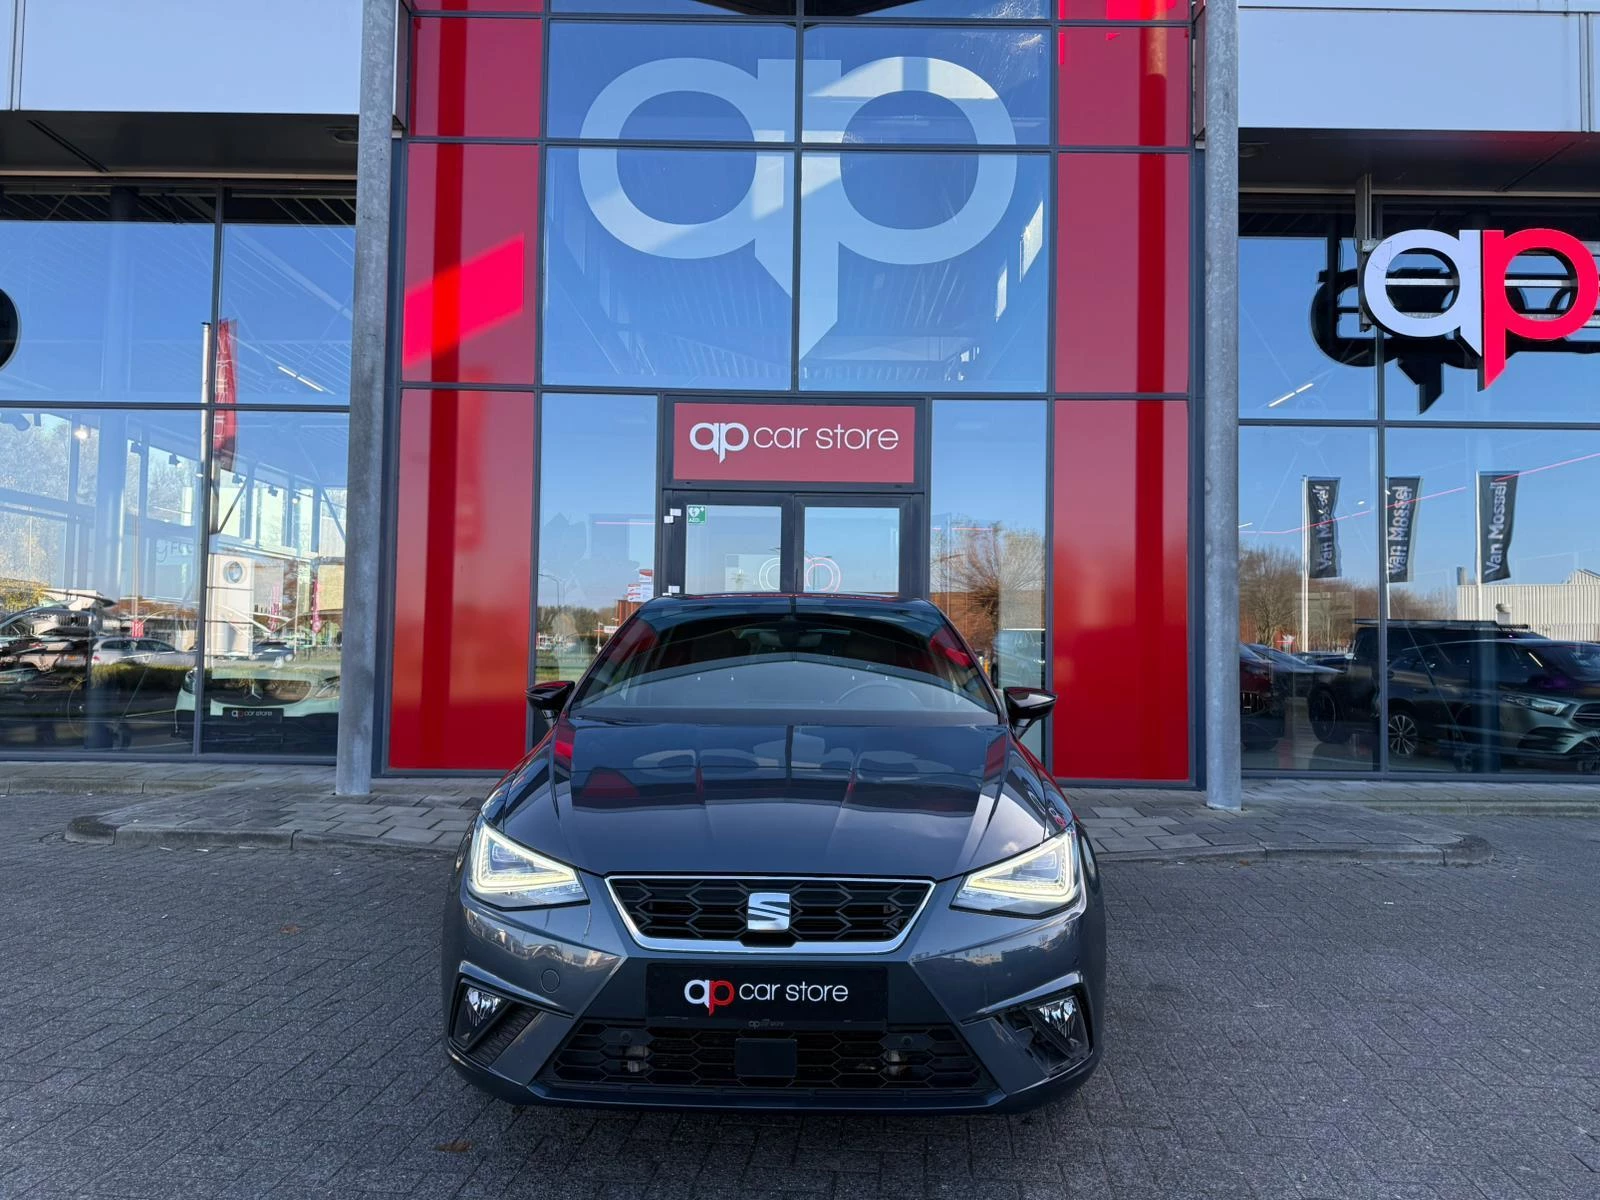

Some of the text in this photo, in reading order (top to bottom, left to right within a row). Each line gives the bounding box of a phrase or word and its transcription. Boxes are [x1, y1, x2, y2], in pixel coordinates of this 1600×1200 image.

[579, 56, 1017, 360] ap
[1363, 228, 1600, 391] ap
[689, 422, 899, 464] ap car store
[1484, 481, 1508, 574] Van Mossel
[684, 979, 849, 1016] ap car store
